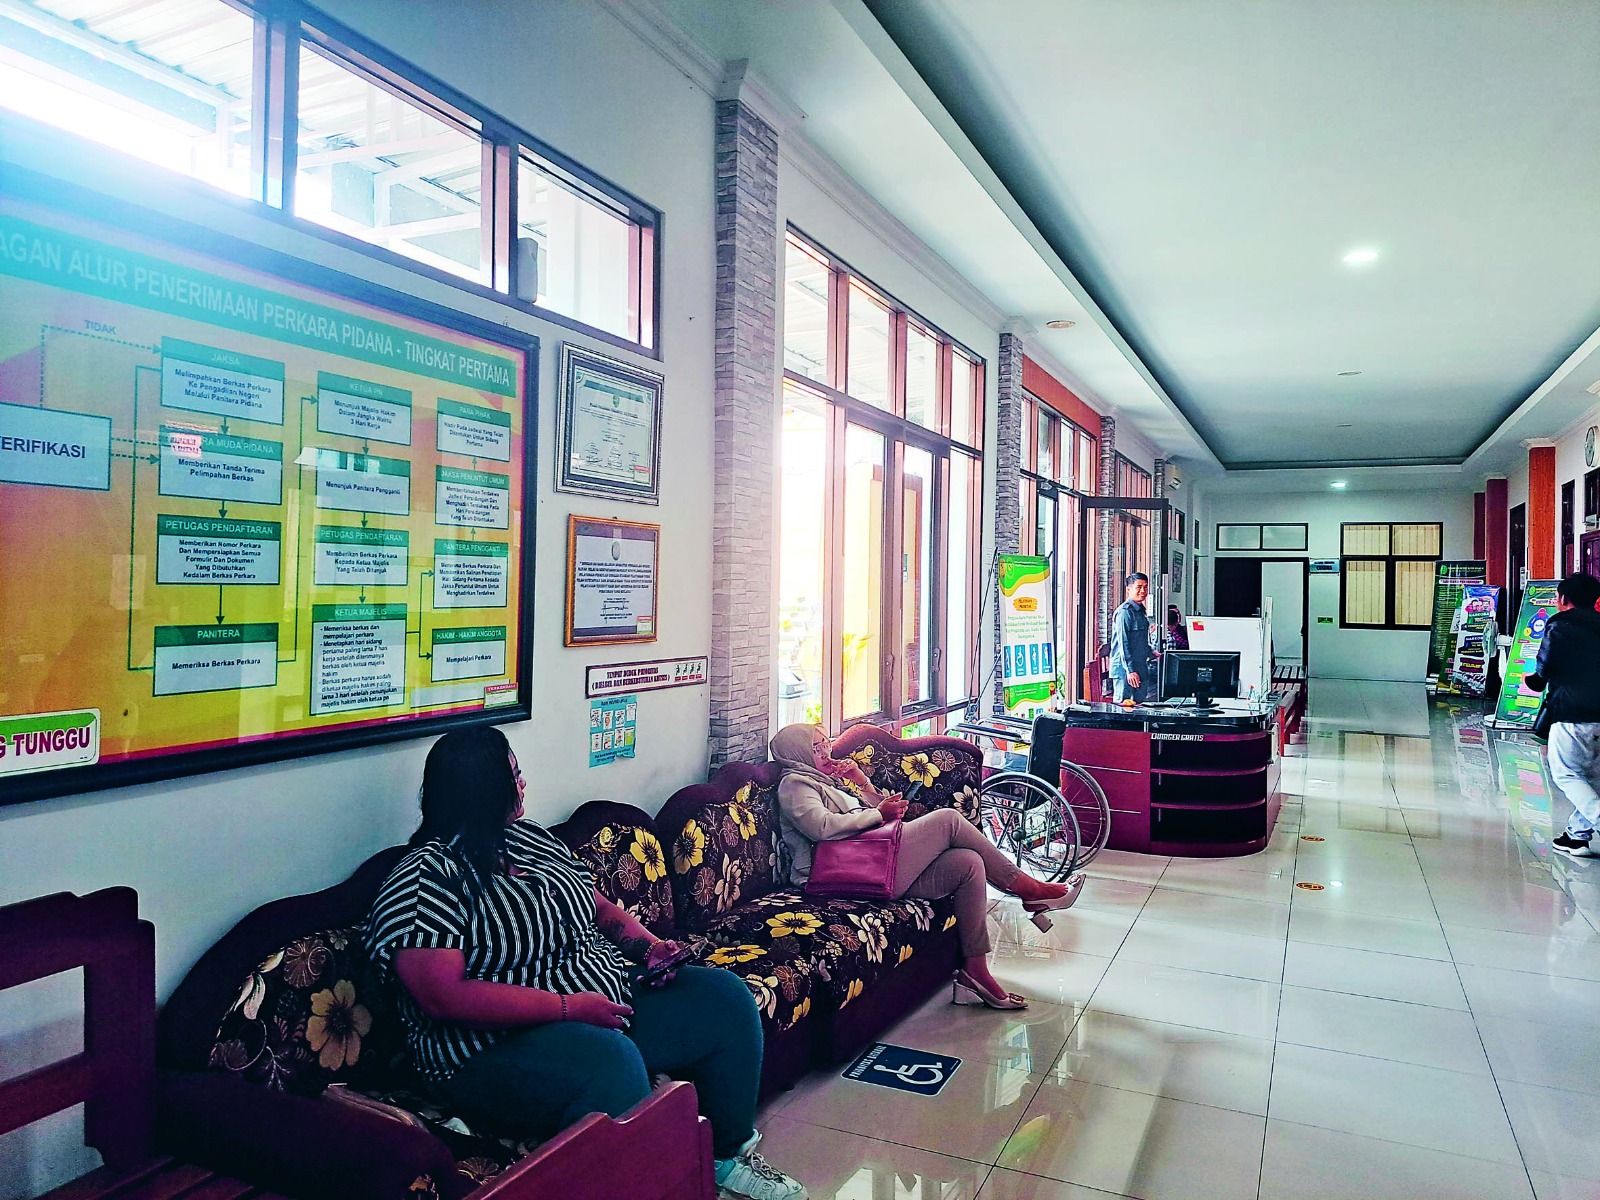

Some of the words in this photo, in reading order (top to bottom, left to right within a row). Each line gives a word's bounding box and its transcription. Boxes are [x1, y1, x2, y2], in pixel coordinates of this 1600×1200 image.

[68, 249, 128, 288] ALUR
[134, 265, 259, 322] PENERIMAAN
[264, 302, 339, 343] PERKARA
[342, 325, 394, 357] PIDANA
[404, 340, 457, 372] TINGKAT
[459, 356, 510, 387] PERTAMA
[84, 319, 117, 335] TIDAK
[212, 354, 239, 365] JAKSA
[175, 369, 221, 383] Melimpahkan
[223, 379, 245, 388] Berkas
[247, 383, 271, 393] Perkara
[185, 389, 209, 398] Melalui
[241, 400, 262, 408] Pidana
[239, 390, 259, 400] Negeri
[0, 435, 85, 459] ERIFIKASI
[217, 439, 242, 450] MUDA
[244, 442, 274, 454] PIDANA
[179, 459, 220, 469] Memberikan
[223, 464, 242, 472] Tanda
[244, 465, 265, 474] Terima
[190, 469, 230, 480] Pelimpahan
[326, 481, 352, 490] Menunjuk
[166, 520, 209, 530] PETUGAS
[211, 523, 273, 534] PENDAFTARAN
[321, 530, 354, 539] PETUGAS
[356, 532, 403, 541] PENDAFTARAN
[179, 539, 216, 547] Memberikan
[218, 540, 238, 548] Nomor
[193, 548, 240, 557] Mempersiapkan
[197, 629, 240, 638] PANITERA
[437, 631, 454, 639] HAKIM
[172, 661, 209, 670] Memeriksa
[13, 727, 90, 756] TUNGGU
